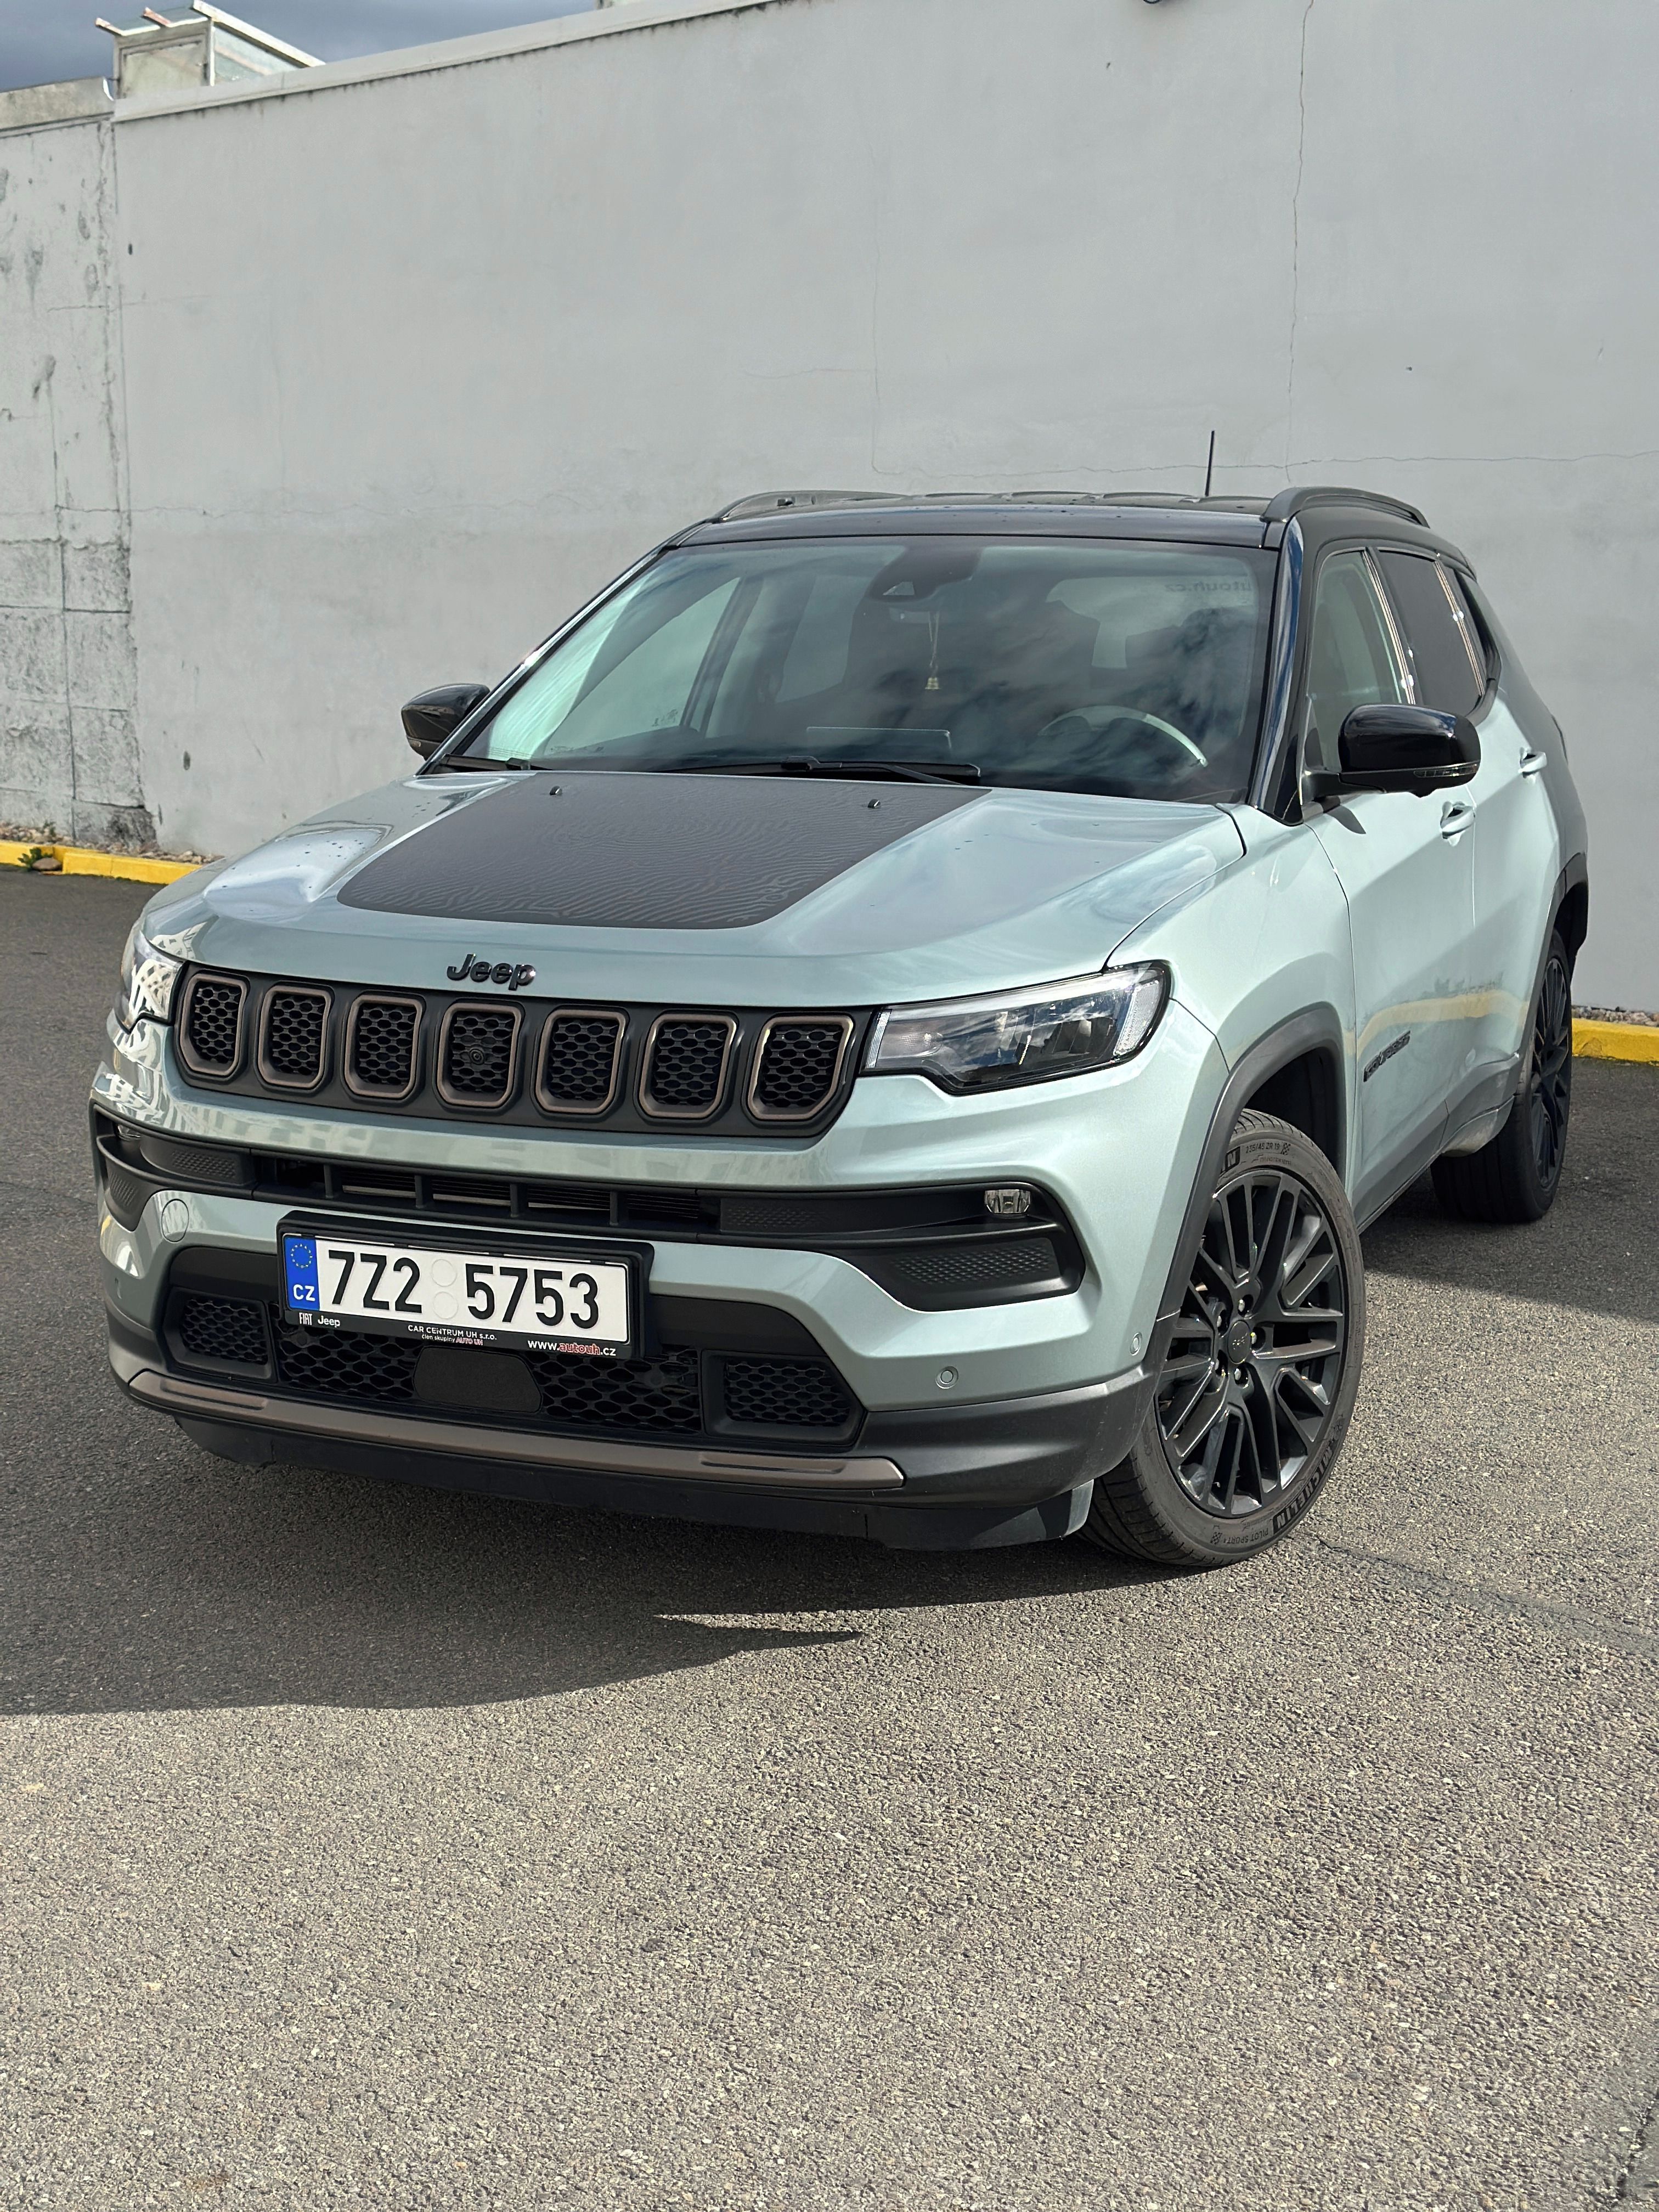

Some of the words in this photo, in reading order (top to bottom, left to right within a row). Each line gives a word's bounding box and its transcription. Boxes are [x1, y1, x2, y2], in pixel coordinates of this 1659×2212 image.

[447, 953, 536, 991] Jeep
[293, 1284, 315, 1301] CZ
[328, 1250, 422, 1314] 7Z2
[465, 1262, 599, 1330] 5753
[298, 1312, 313, 1326] FIAT
[317, 1315, 341, 1328] Jeep
[408, 1324, 424, 1333] CAR
[426, 1327, 464, 1338] CENTRUM
[466, 1330, 477, 1339] UH
[434, 1335, 455, 1344] skupiny
[455, 1336, 473, 1345] AUTO
[527, 1340, 617, 1356] www.autouh.cz
[1276, 1447, 1333, 1530] MICHELIN
[1250, 1527, 1268, 1542] PILOT
